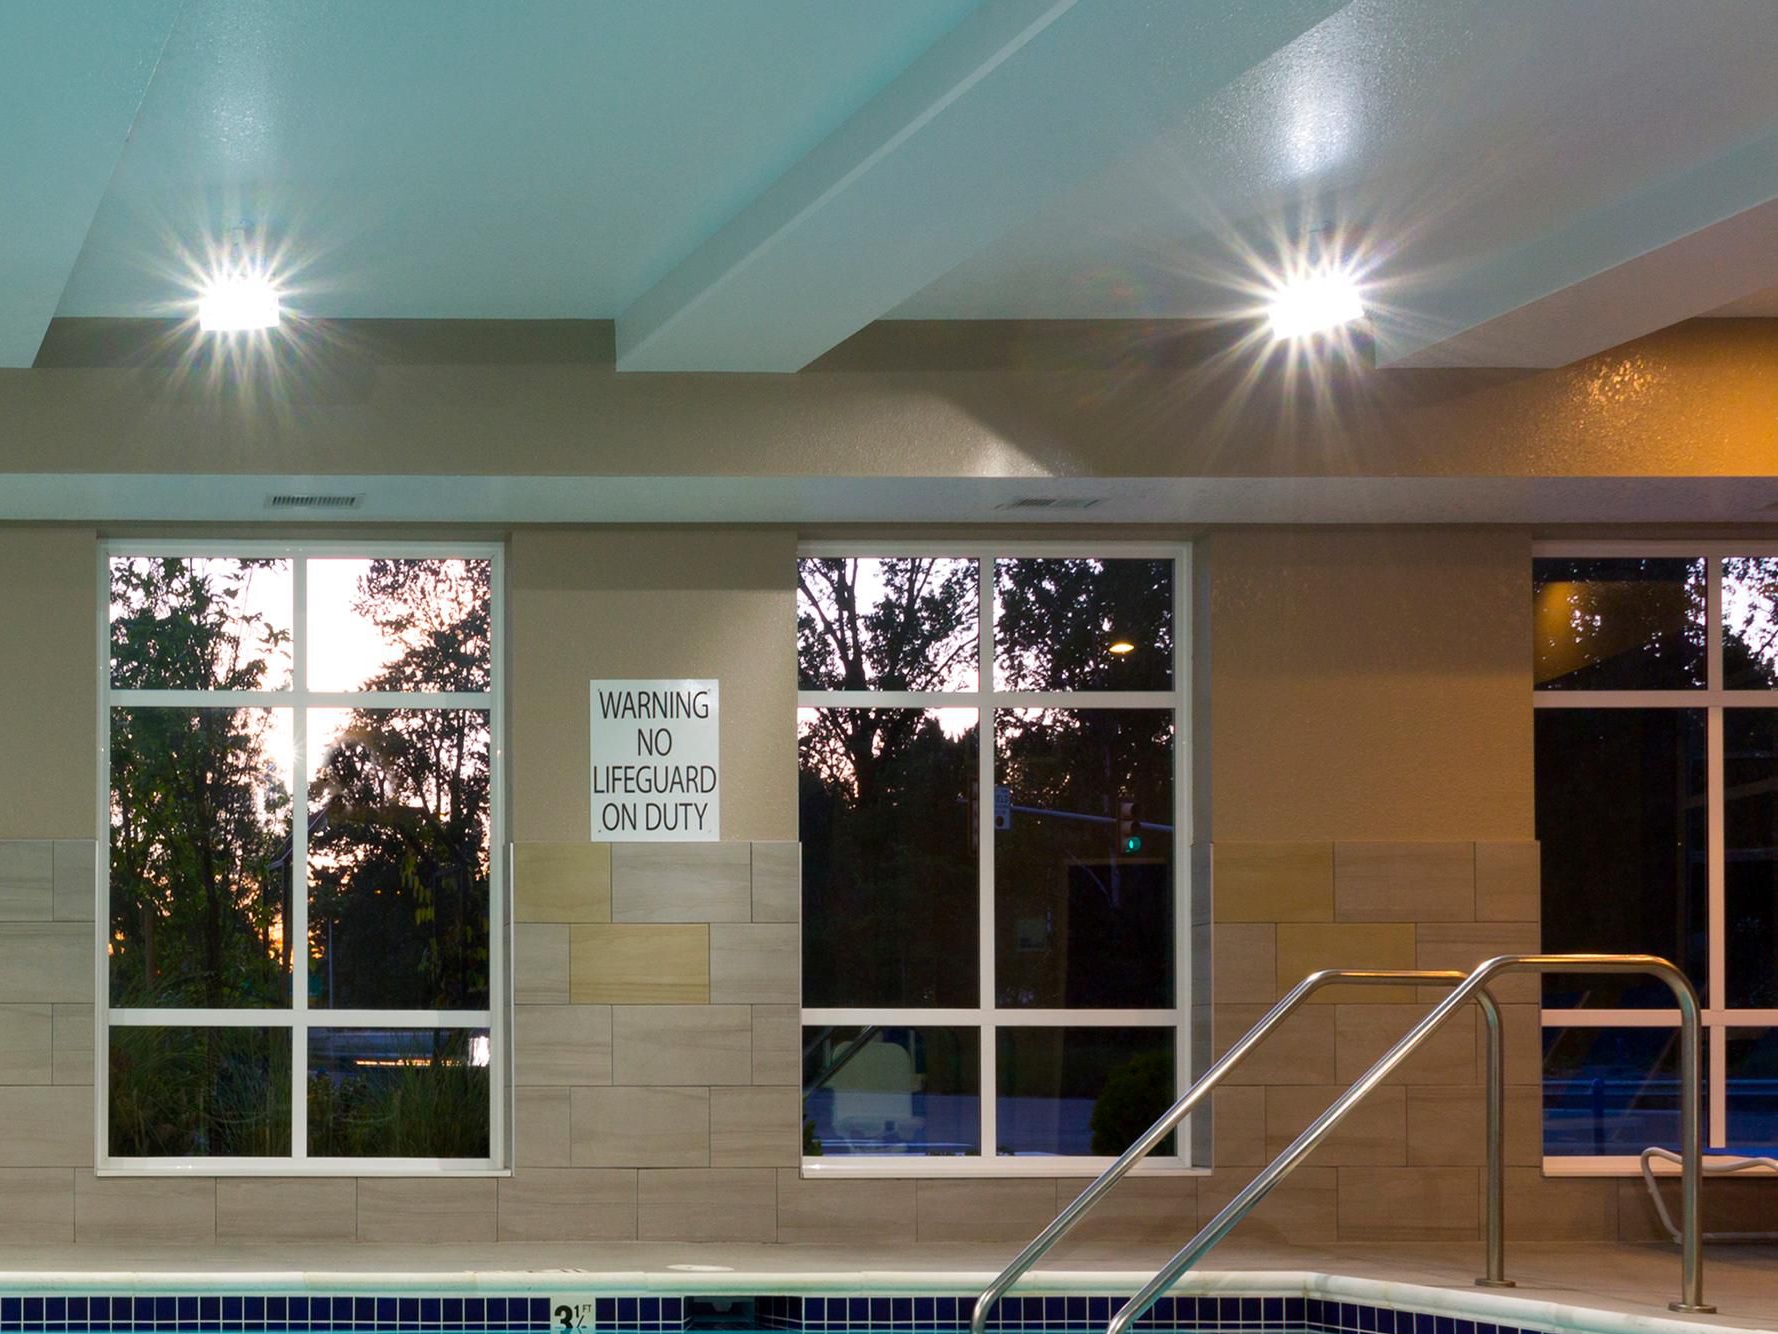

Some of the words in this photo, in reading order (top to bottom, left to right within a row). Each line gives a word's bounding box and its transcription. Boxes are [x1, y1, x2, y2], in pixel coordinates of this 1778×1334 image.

[599, 691, 709, 719] WARNING
[637, 728, 672, 756] NO
[593, 765, 717, 794] LIFEGUARD
[602, 802, 637, 831] ON
[645, 802, 709, 831] DUTY
